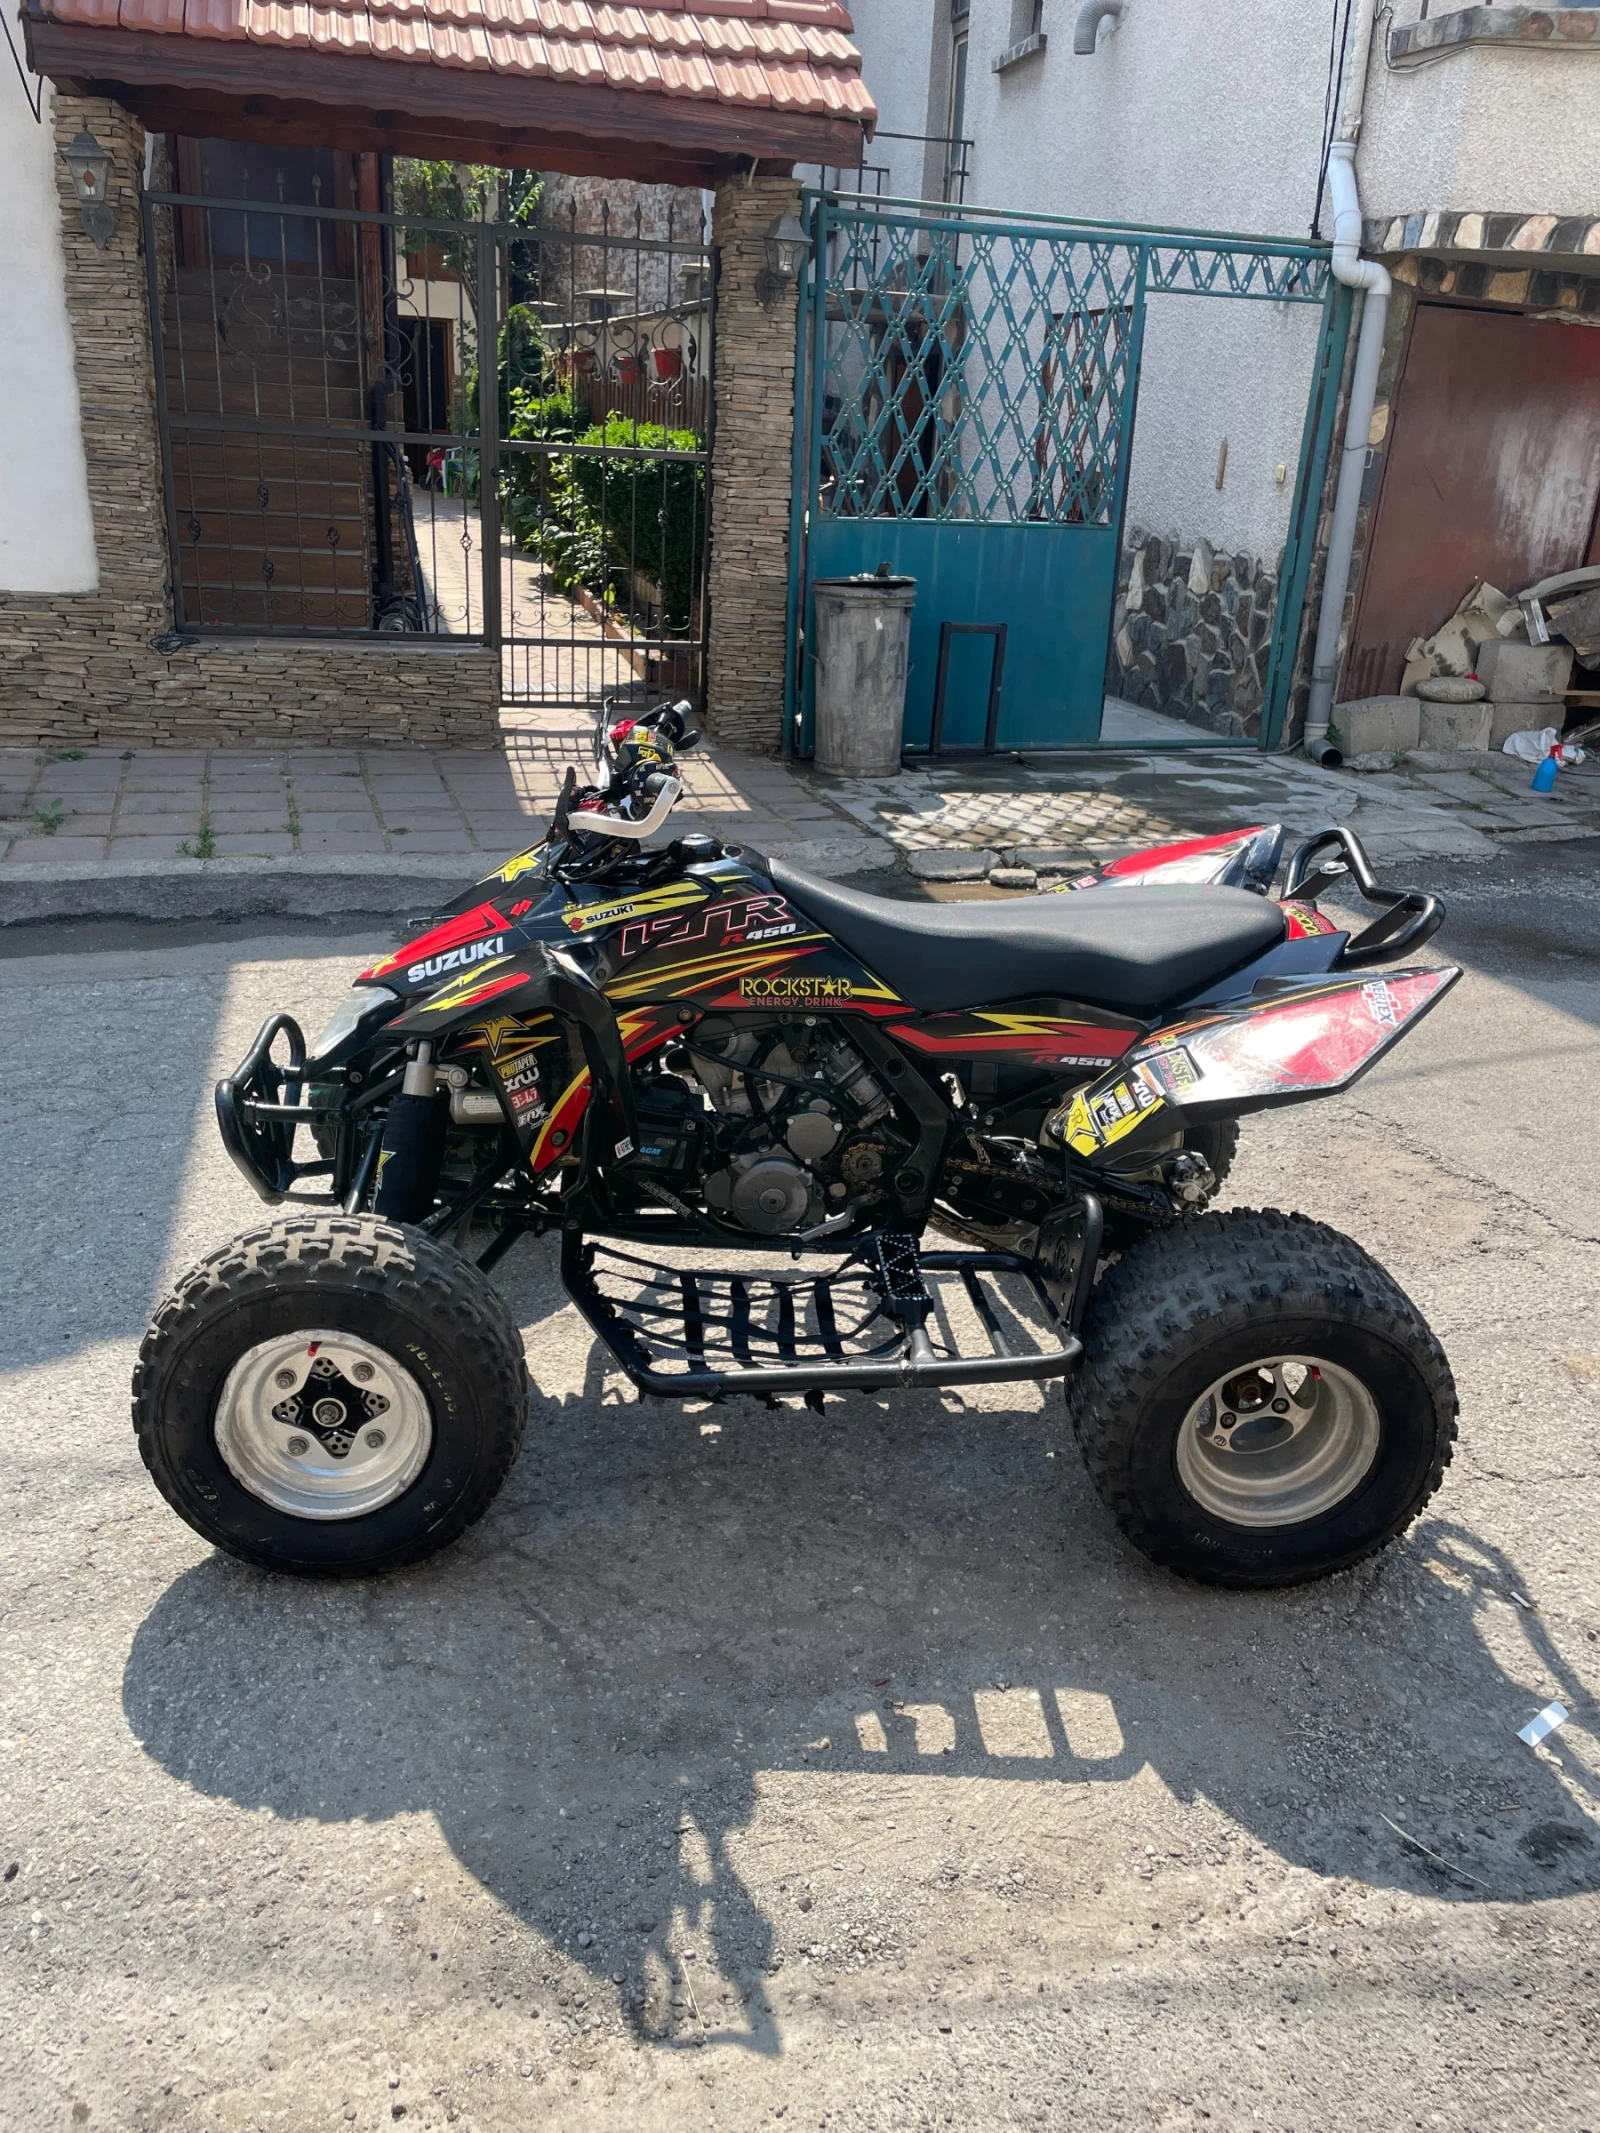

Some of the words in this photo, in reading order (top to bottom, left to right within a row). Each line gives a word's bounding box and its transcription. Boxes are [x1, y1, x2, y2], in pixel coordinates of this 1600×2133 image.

[585, 904, 635, 924] SUZUKI
[407, 936, 504, 983] SUZUKI
[749, 996, 800, 1006] ENERGY
[804, 997, 842, 1007] DRINK
[1371, 981, 1395, 1023] VERTEX
[1032, 1055, 1112, 1067] R450
